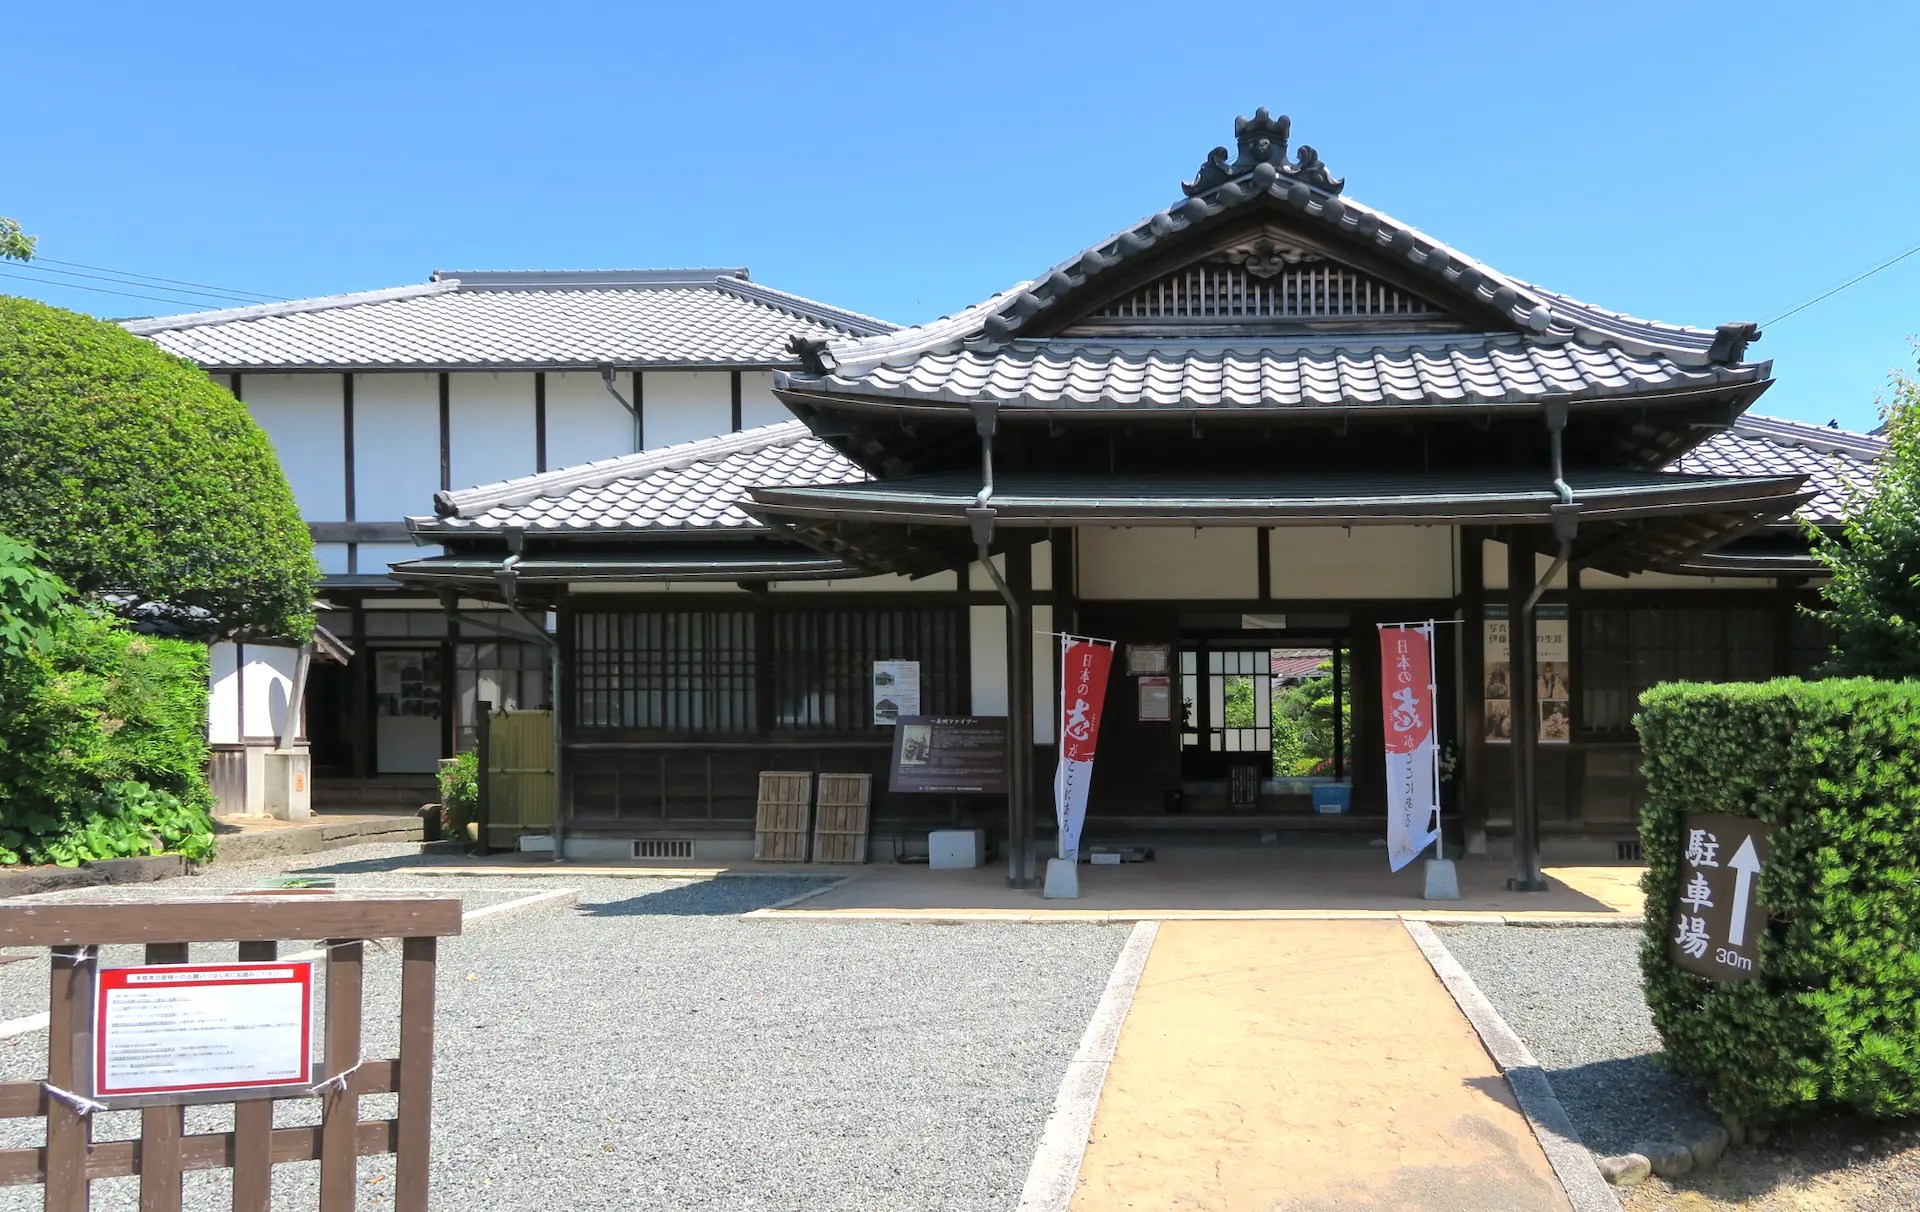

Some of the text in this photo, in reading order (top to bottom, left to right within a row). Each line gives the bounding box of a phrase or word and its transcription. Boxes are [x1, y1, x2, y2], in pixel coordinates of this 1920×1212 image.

[1675, 829, 1719, 959] 駐車場
[1716, 948, 1752, 971] 30m
